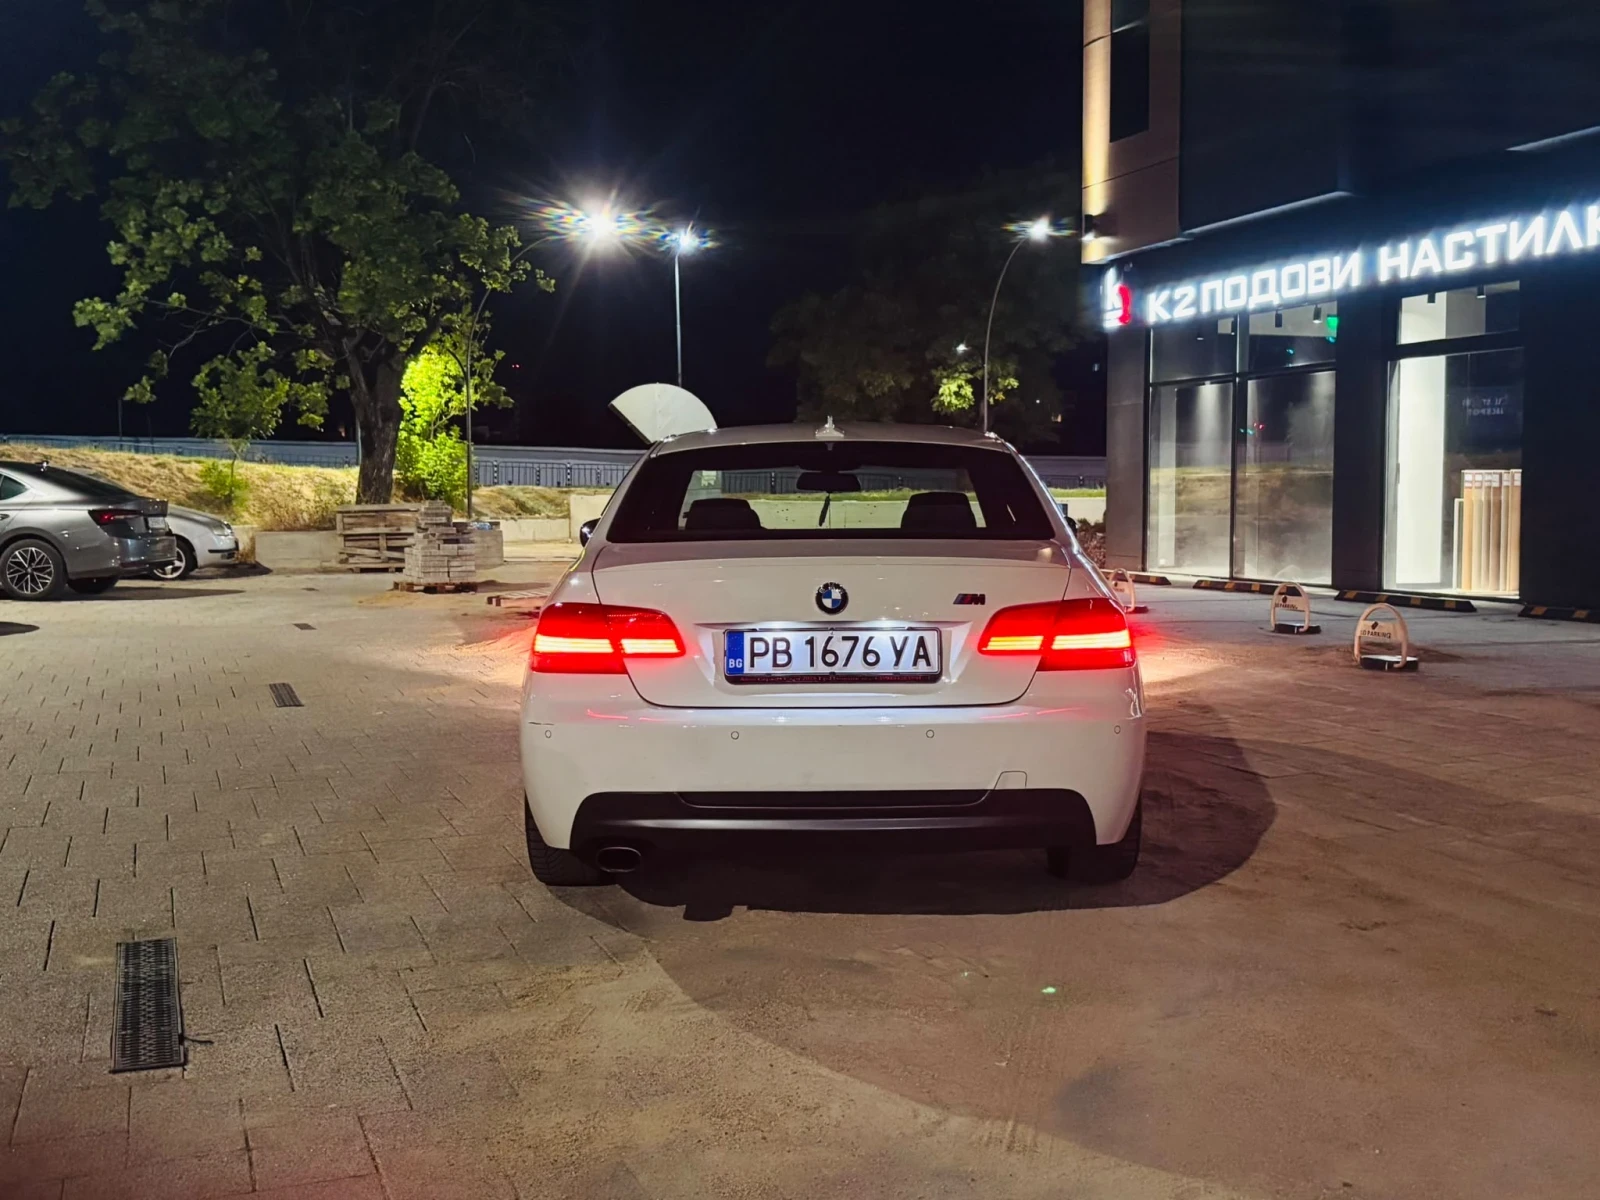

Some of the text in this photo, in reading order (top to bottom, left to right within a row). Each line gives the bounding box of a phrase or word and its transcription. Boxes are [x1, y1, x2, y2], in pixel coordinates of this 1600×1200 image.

[1201, 252, 1361, 313] ПОДОВИ
[1367, 630, 1392, 639] PARKING
[749, 635, 932, 668] PB 1676 YA
[728, 658, 743, 668] BG
